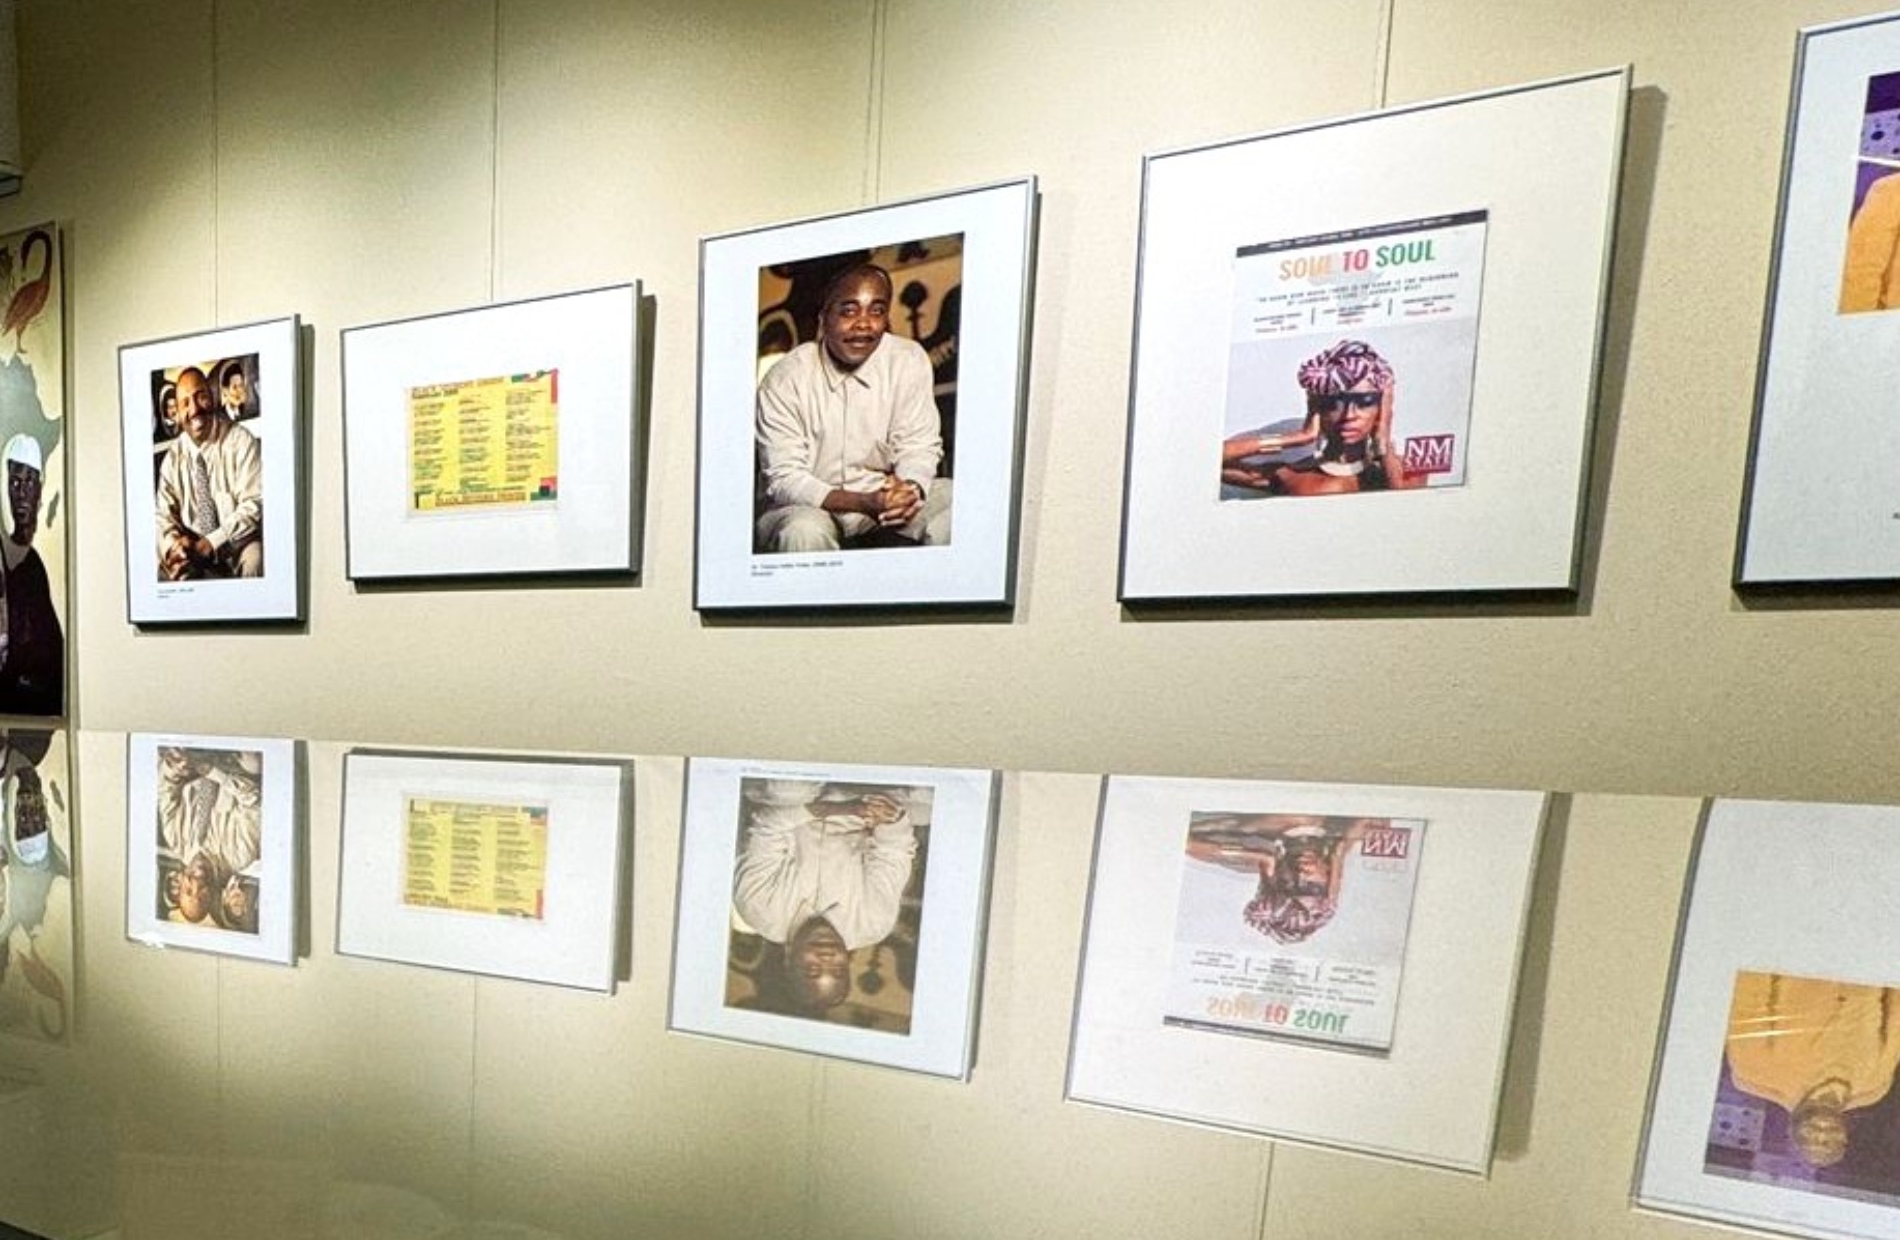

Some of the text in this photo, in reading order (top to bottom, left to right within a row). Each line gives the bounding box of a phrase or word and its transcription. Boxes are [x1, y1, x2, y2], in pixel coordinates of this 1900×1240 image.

[1342, 249, 1369, 273] TO
[1375, 239, 1437, 268] SOUL
[1408, 438, 1451, 457] NM
